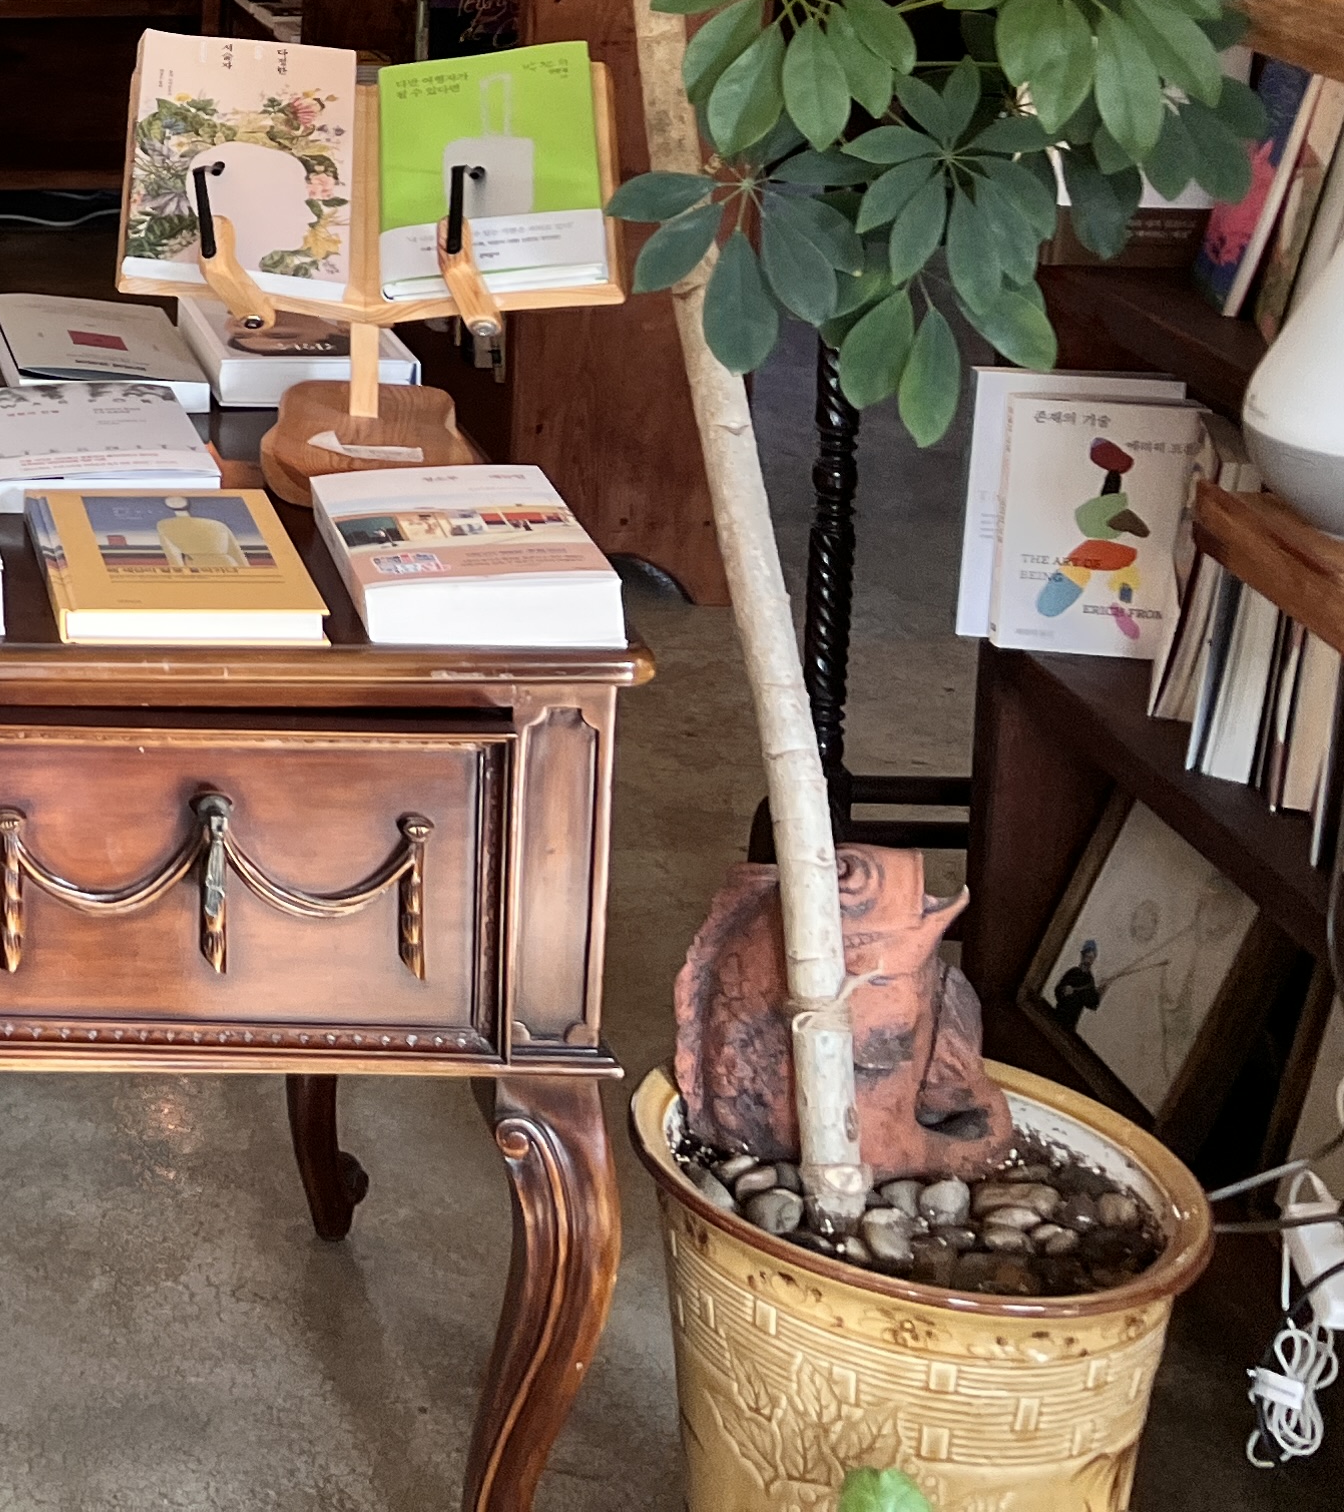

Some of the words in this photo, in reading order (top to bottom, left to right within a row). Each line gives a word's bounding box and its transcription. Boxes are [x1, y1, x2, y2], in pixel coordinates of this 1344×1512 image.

[1034, 410, 1077, 426] 존재의
[1081, 413, 1112, 429] 기술
[1019, 552, 1050, 566] THE
[1052, 556, 1079, 567] ART
[1018, 569, 1064, 584] BEING
[1082, 603, 1126, 617] ERICH
